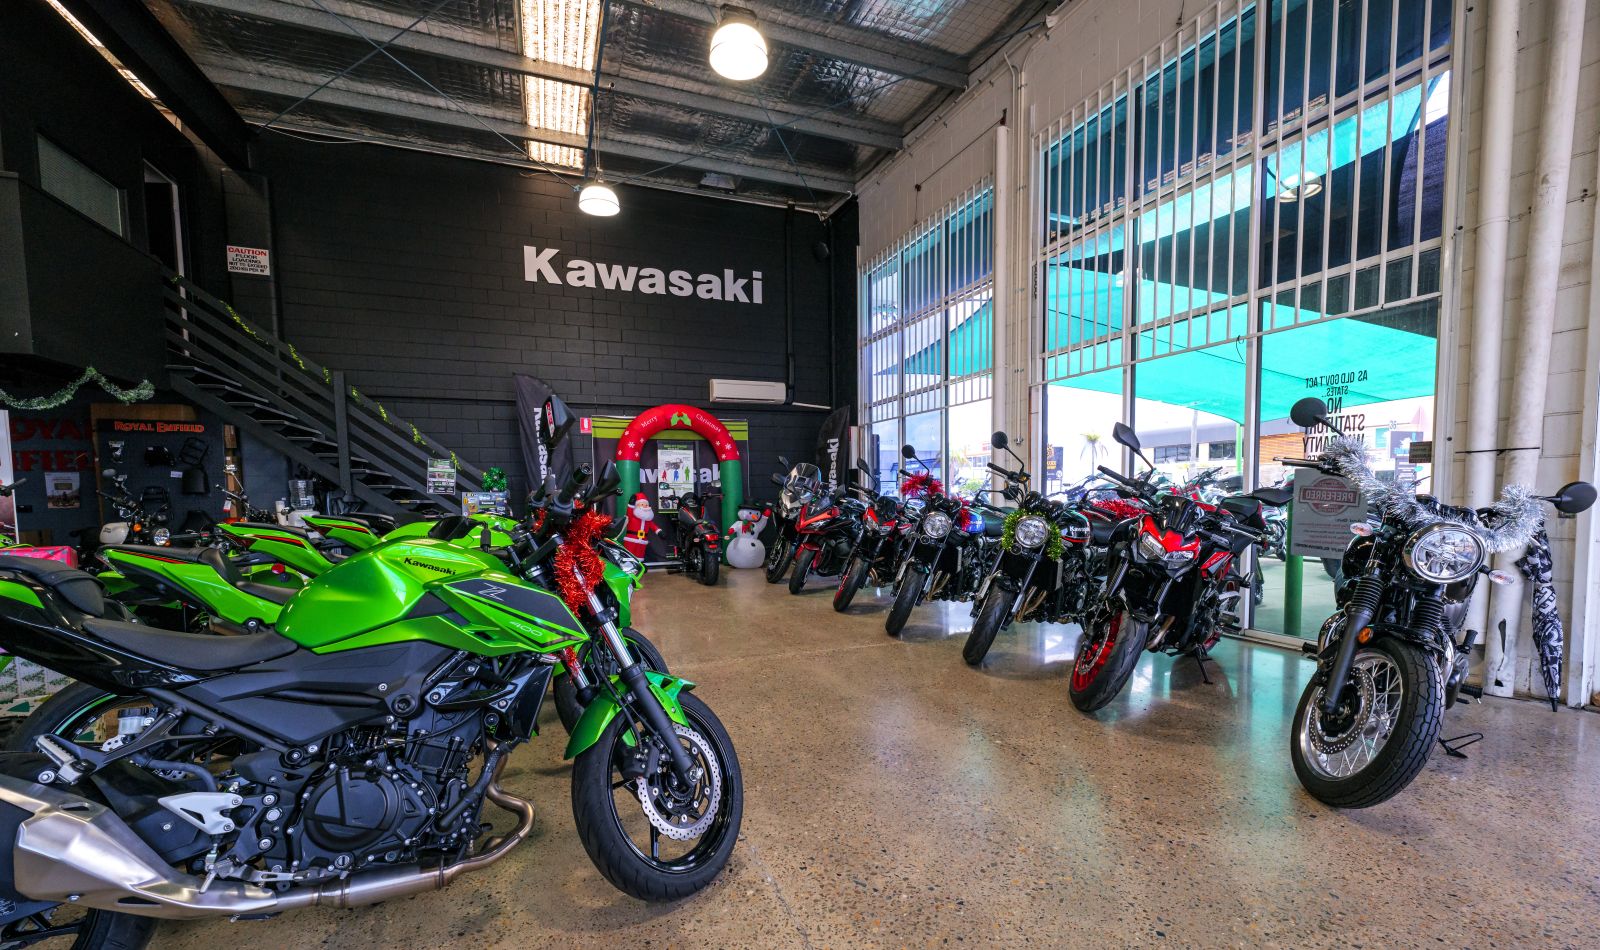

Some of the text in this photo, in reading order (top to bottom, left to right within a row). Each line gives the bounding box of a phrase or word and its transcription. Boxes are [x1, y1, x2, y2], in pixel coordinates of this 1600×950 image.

[228, 246, 267, 256] CAUTION
[523, 245, 763, 304] Kawasaki
[10, 416, 92, 441] OYA
[114, 421, 205, 433] ROYAL ENFIELD
[641, 413, 722, 432] Merry Christmas
[827, 438, 840, 495] wasaki
[404, 557, 457, 576] Kawasaki
[509, 620, 544, 637] 400
